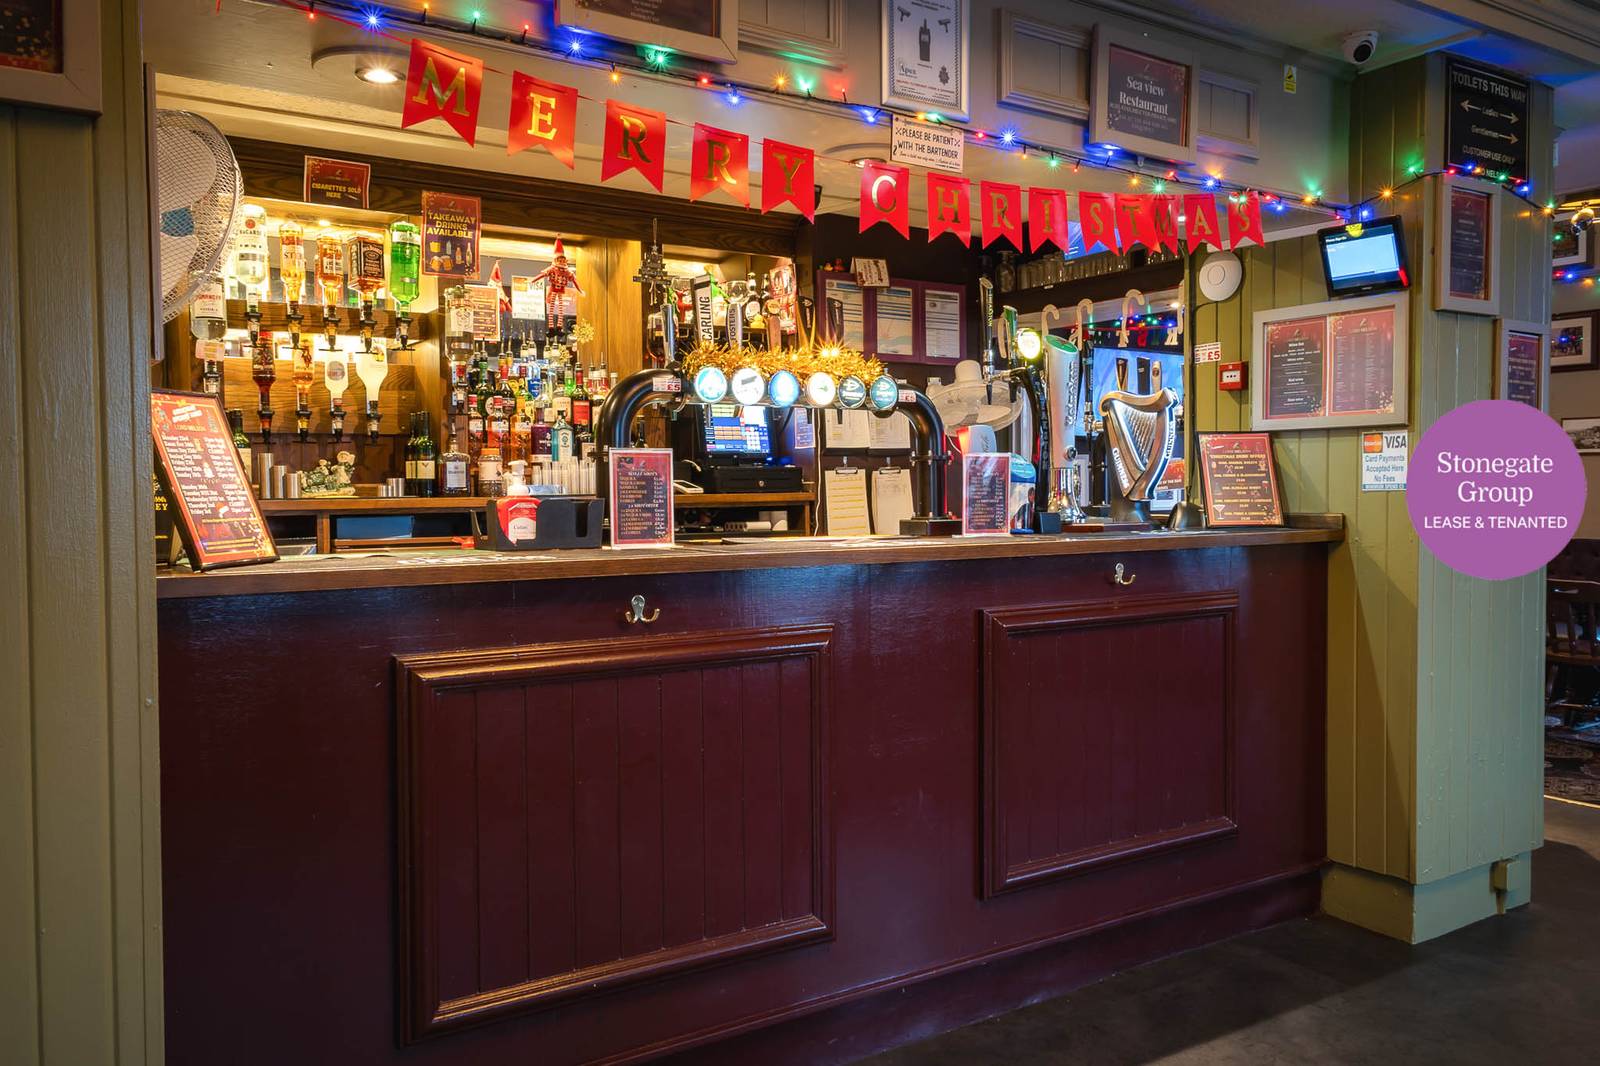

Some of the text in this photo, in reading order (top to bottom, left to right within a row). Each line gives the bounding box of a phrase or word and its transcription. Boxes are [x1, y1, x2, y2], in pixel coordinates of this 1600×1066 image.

[1127, 76, 1165, 96] Sea view
[1453, 71, 1526, 103] TOILETS THIS WAY
[1120, 91, 1168, 116] Restaurant
[412, 57, 805, 196] MERRY
[902, 127, 954, 146] PLEASE BE PATIENT
[897, 140, 913, 151] WITH
[915, 143, 926, 153] THE
[927, 146, 959, 159] BARTENDER
[311, 183, 362, 195] CIGARETTES SOLD
[871, 175, 1251, 237] CHRISTMAS
[428, 211, 476, 225] TAKEAWAY
[435, 220, 468, 231] DRINKS
[426, 227, 474, 239] AVAILABLE
[699, 296, 713, 341] CARLING
[1207, 351, 1220, 361] £5
[1384, 435, 1407, 448] VISA
[1365, 454, 1405, 464] Card Payments
[1366, 464, 1391, 474] Accepted
